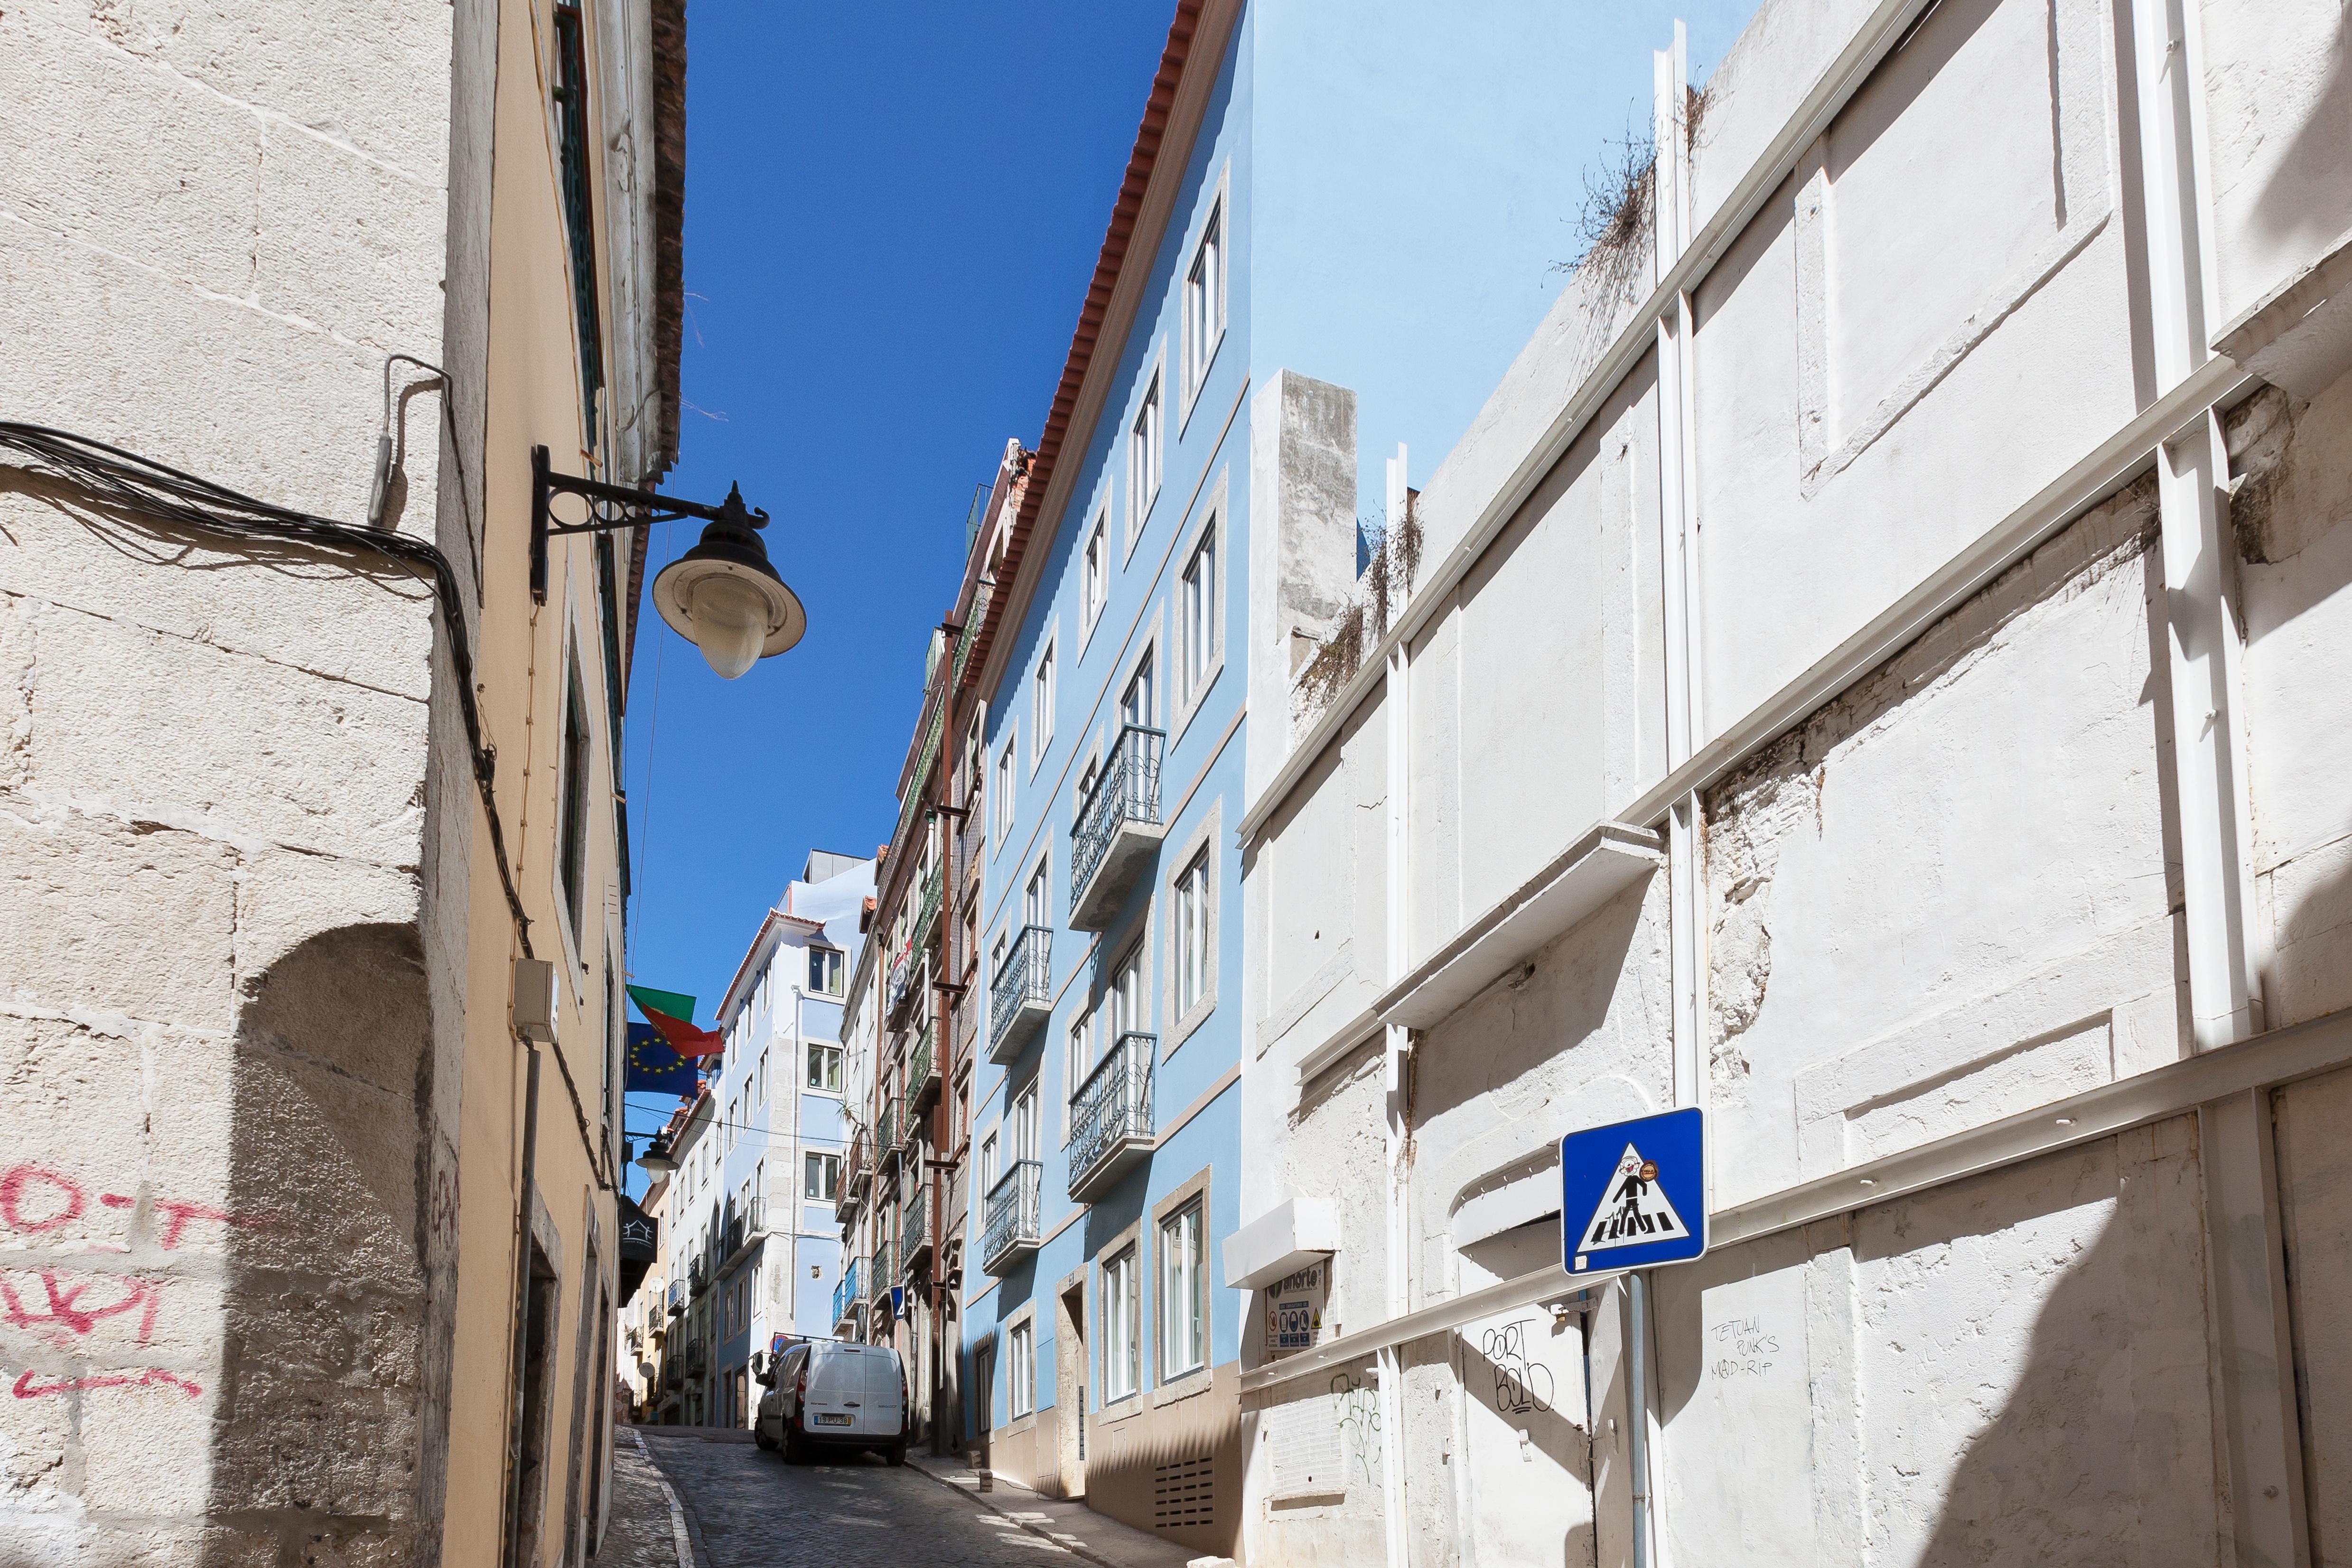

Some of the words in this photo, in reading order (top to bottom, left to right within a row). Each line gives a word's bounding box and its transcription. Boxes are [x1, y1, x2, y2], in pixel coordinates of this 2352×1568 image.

[1711, 1314, 1760, 1342] TETUAN
[1483, 1319, 1536, 1371] PORT
[1736, 1334, 1780, 1356] PUNK'S
